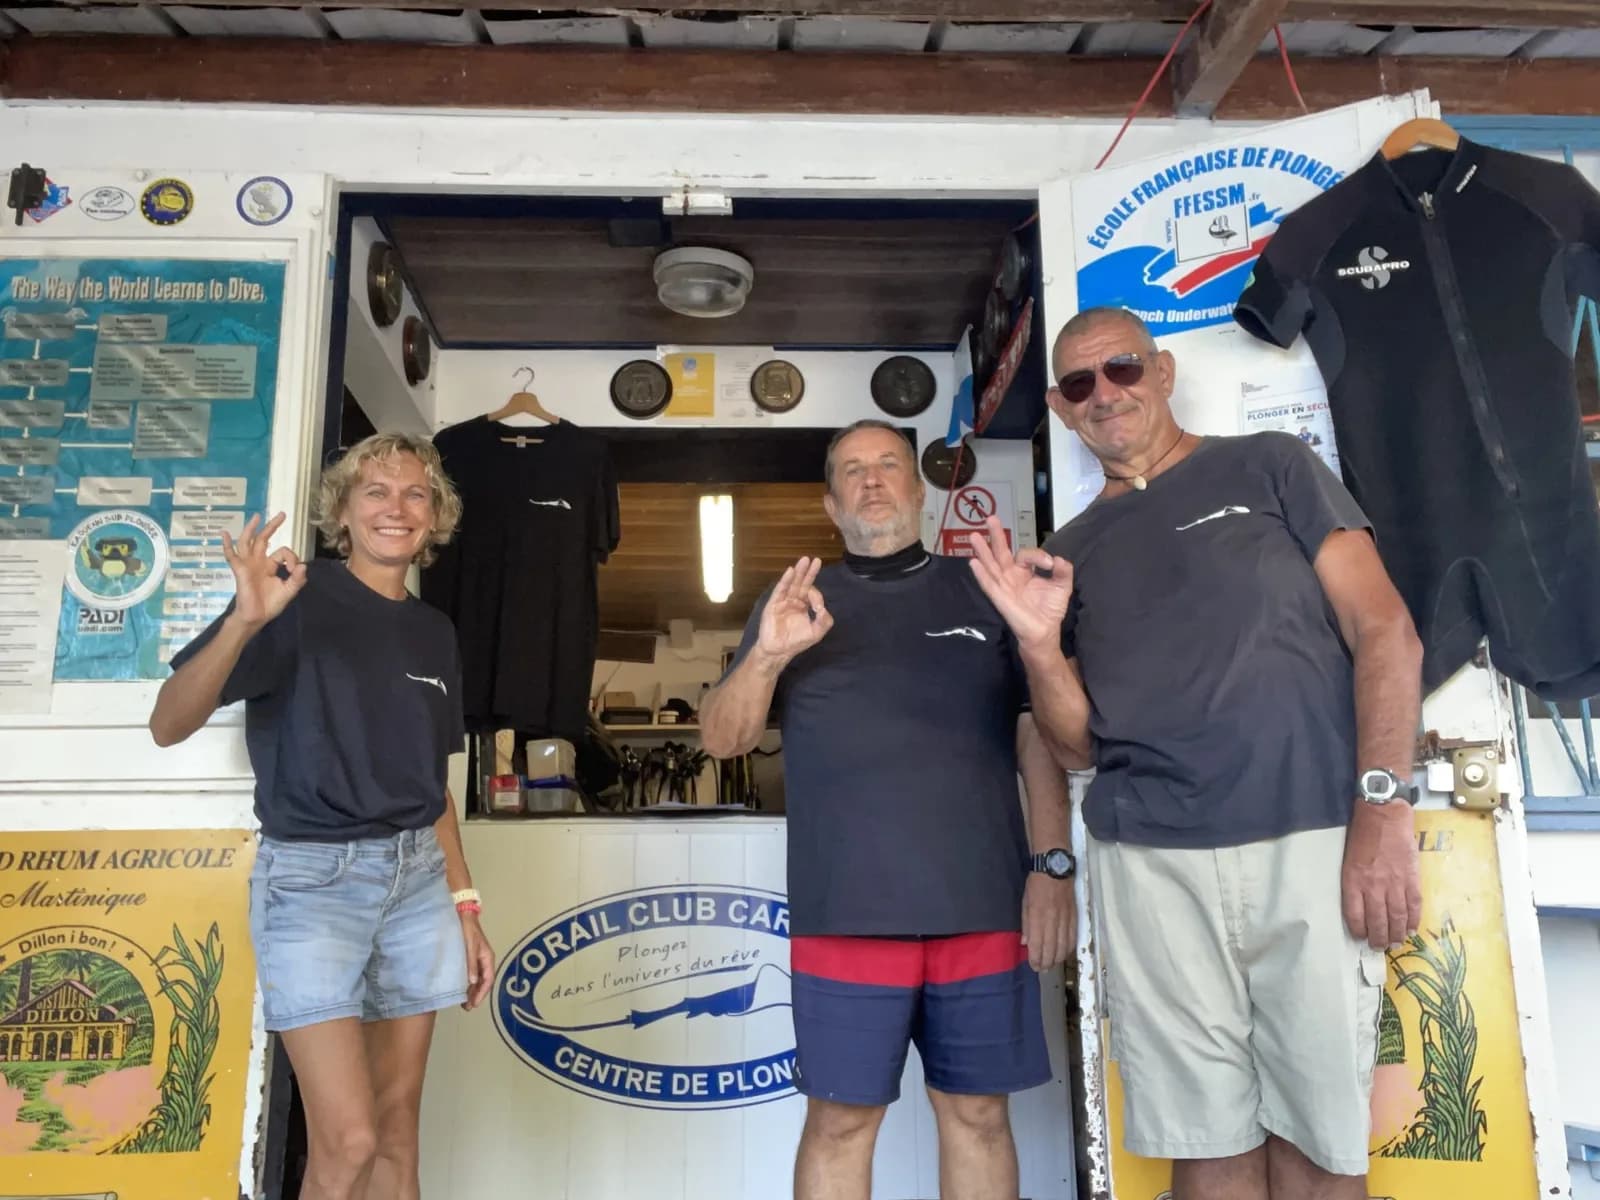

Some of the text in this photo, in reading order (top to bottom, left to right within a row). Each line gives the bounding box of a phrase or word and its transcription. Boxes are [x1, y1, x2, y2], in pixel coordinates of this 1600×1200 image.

[1087, 194, 1138, 250] ÉCOLE
[1131, 148, 1238, 206] FRANÇAISE
[1242, 147, 1269, 168] DE
[1268, 148, 1346, 192] PLONGÉ
[1173, 182, 1246, 219] FFESSM
[1337, 260, 1410, 276] SCUBAPRO
[11, 276, 40, 300] The
[45, 276, 76, 305] Way
[80, 277, 104, 300] the
[109, 276, 149, 300] World
[154, 276, 205, 302] Learns
[209, 278, 224, 301] to
[1166, 302, 1238, 323] Underwat
[1247, 408, 1289, 421] PLONGER
[1292, 406, 1304, 414] EN
[79, 607, 124, 624] PADI
[1415, 830, 1454, 852] LE
[16, 849, 100, 871] RHUM
[101, 847, 237, 870] AGRICOLE
[0, 880, 147, 916] Martinique
[18, 932, 66, 955] Dillon
[70, 930, 77, 944] i
[505, 897, 790, 998] CORAIL CLUB CAR
[617, 939, 688, 962] Plongez
[551, 948, 761, 1000] dans l'univers du rêve
[26, 1008, 99, 1024] DILLON
[554, 1046, 801, 1095] CENTRE DE PLON
